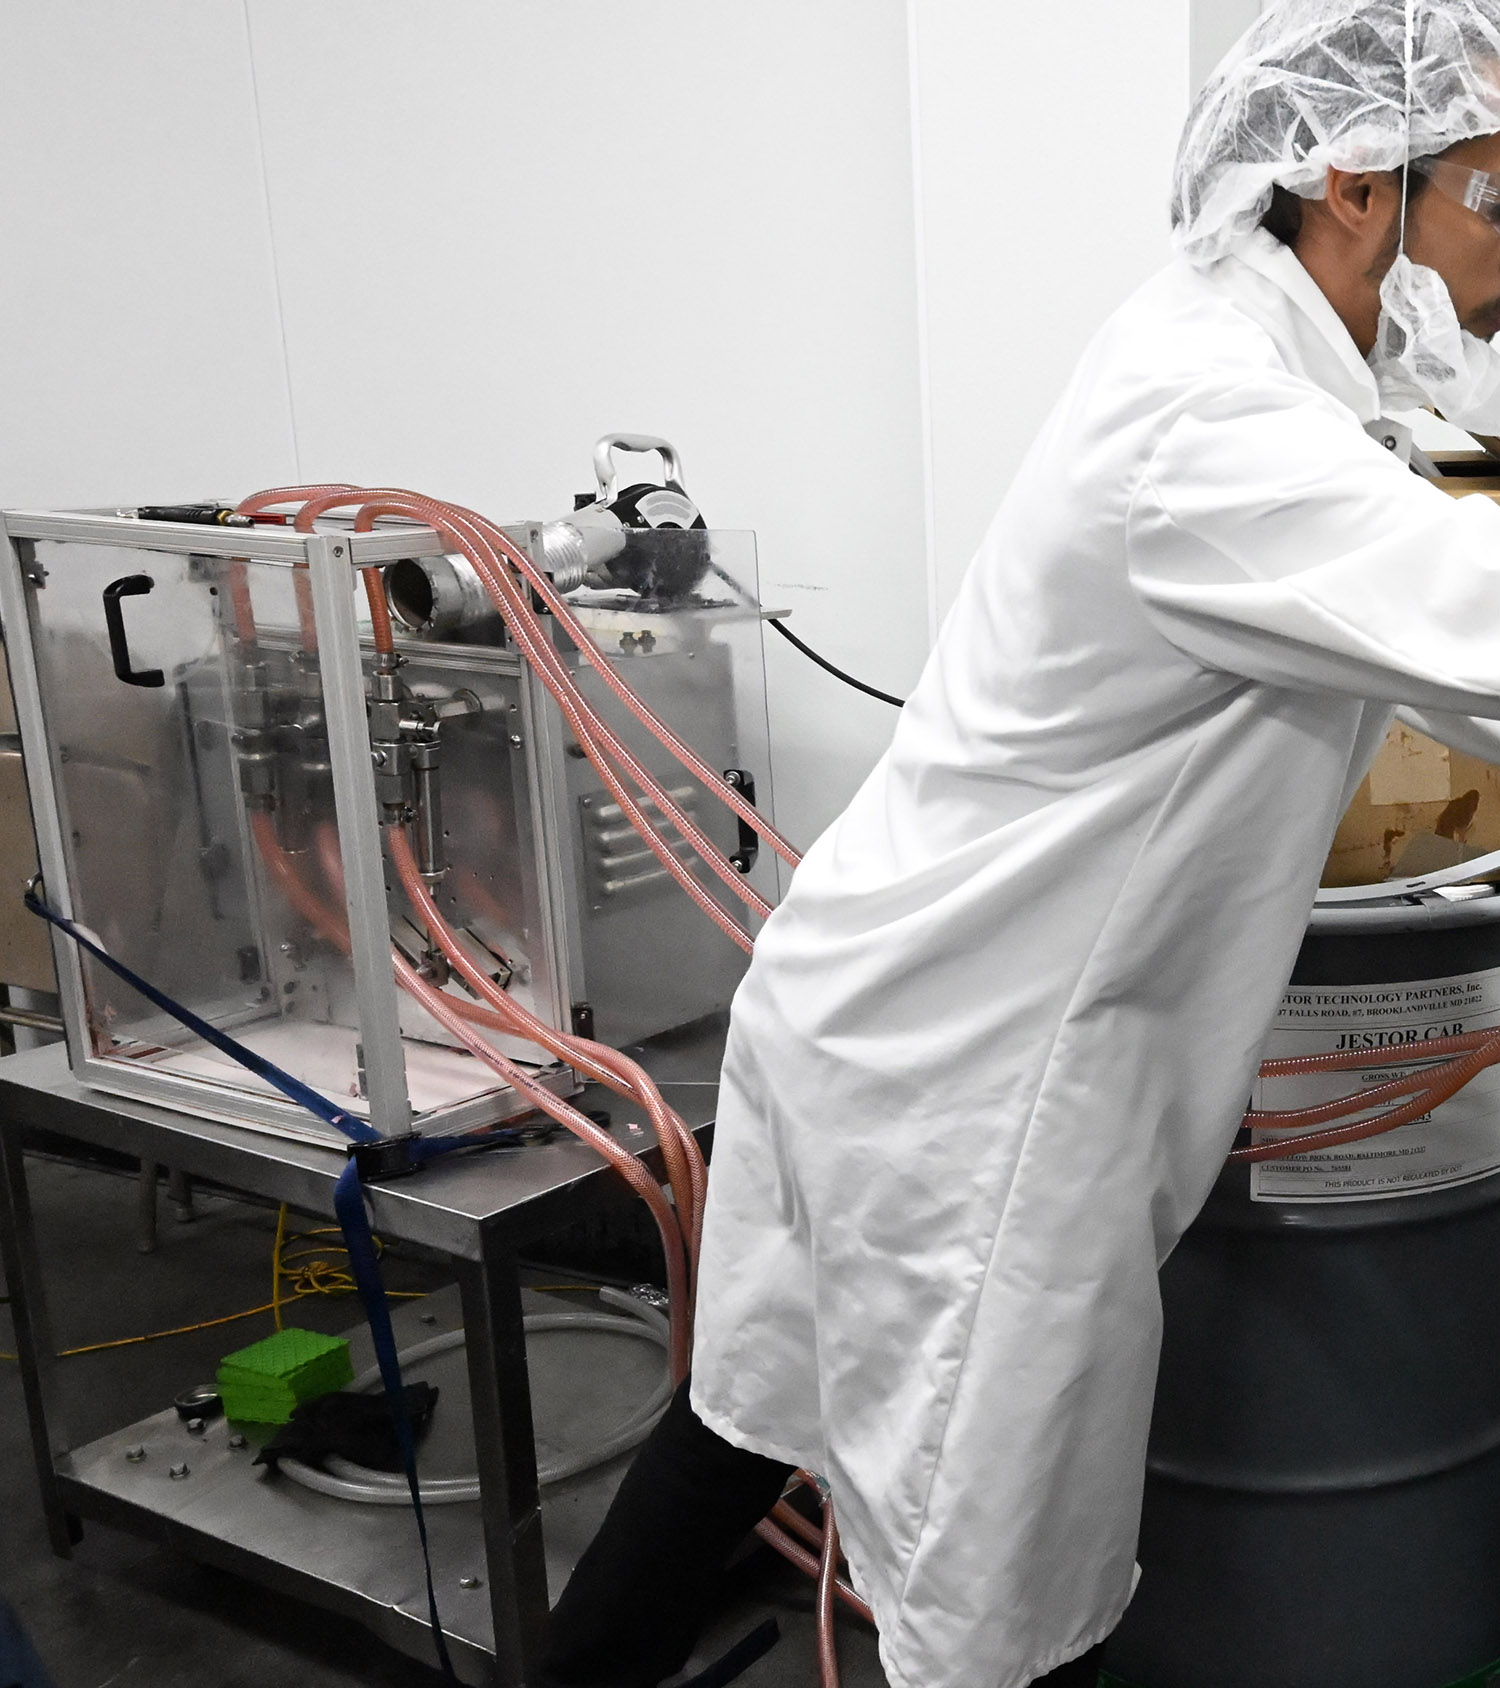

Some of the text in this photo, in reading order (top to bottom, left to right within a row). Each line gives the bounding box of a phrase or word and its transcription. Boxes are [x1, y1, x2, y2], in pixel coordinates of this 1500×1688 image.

[1315, 993, 1401, 1005] TECHNOLOGY
[1405, 985, 1465, 1001] PARTNERS,
[1466, 983, 1482, 992] Inc.
[1289, 1009, 1319, 1017] FALLS
[1366, 1001, 1448, 1016] BROOKLANDVILLE
[1449, 998, 1463, 1007] MD
[1336, 1029, 1418, 1050] JESTOR
[1361, 1072, 1390, 1080] GROSS
[1343, 1179, 1375, 1187] PRODUCT
[1387, 1176, 1400, 1184] NOT
[1402, 1169, 1439, 1181] REGULATED
[1441, 1167, 1450, 1175] BY
